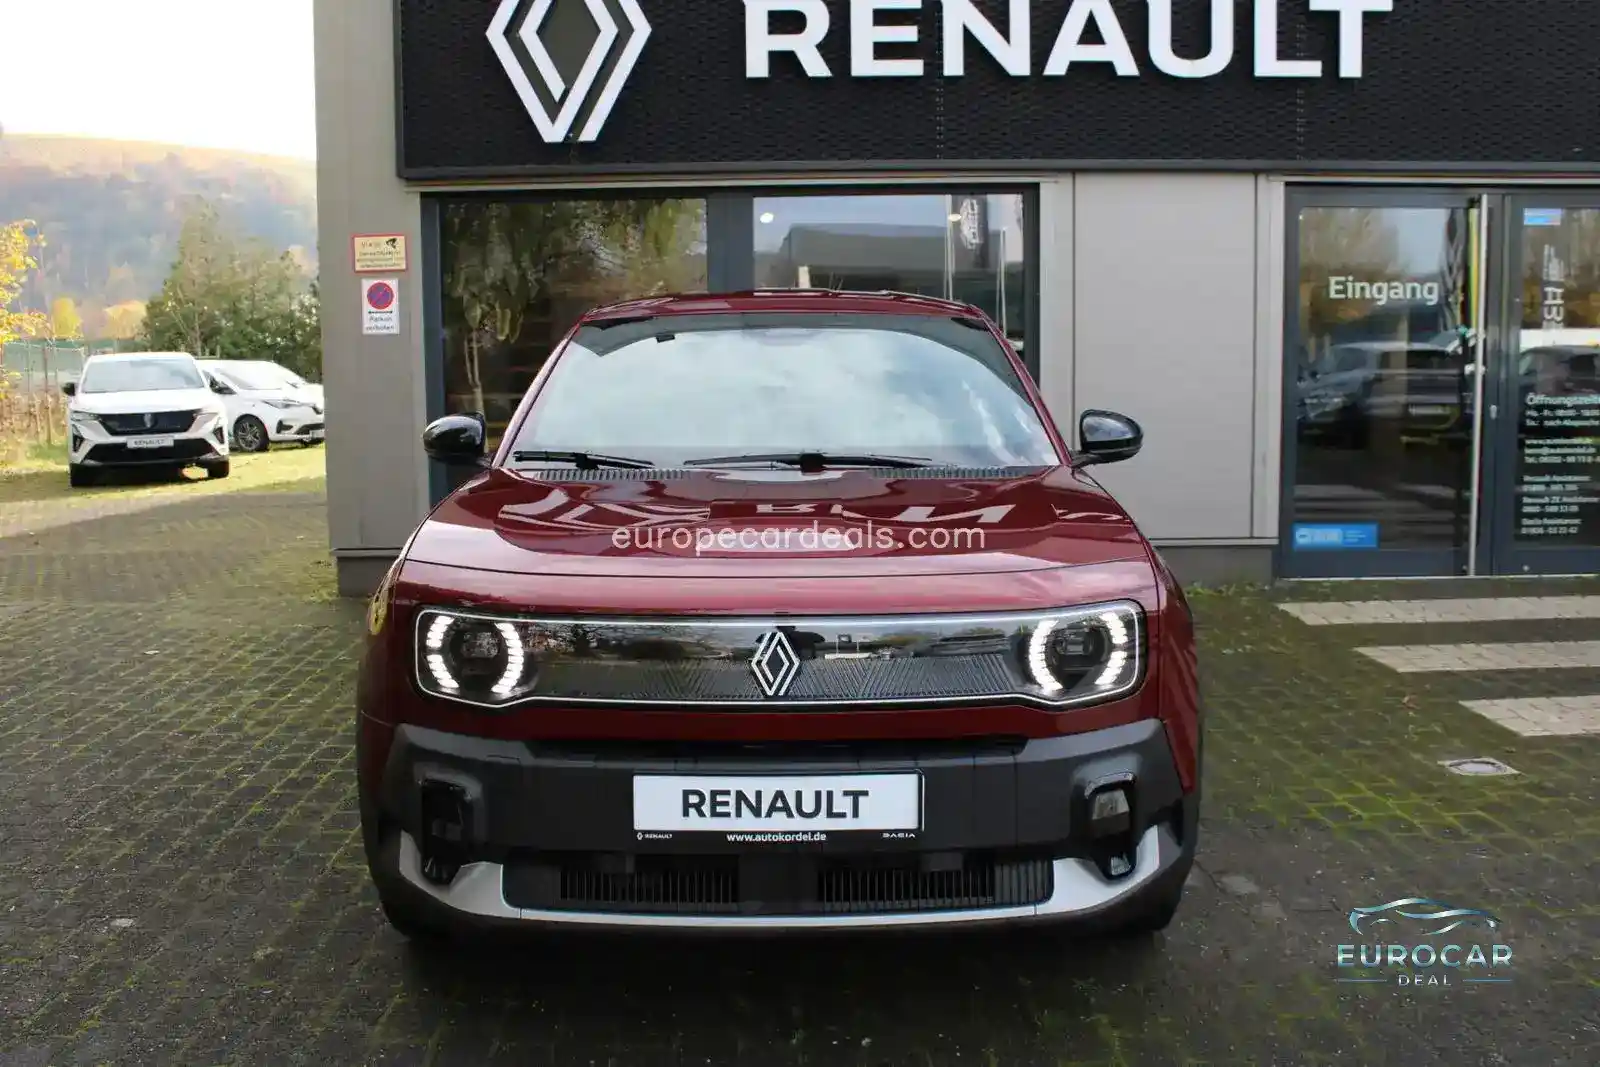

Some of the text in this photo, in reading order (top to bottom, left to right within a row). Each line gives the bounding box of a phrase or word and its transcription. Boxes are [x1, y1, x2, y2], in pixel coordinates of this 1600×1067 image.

[743, 0, 1393, 78] RENAULT
[1329, 275, 1439, 306] Eingang
[682, 788, 869, 819] RENAULT
[726, 831, 827, 842] www.autokordel.de
